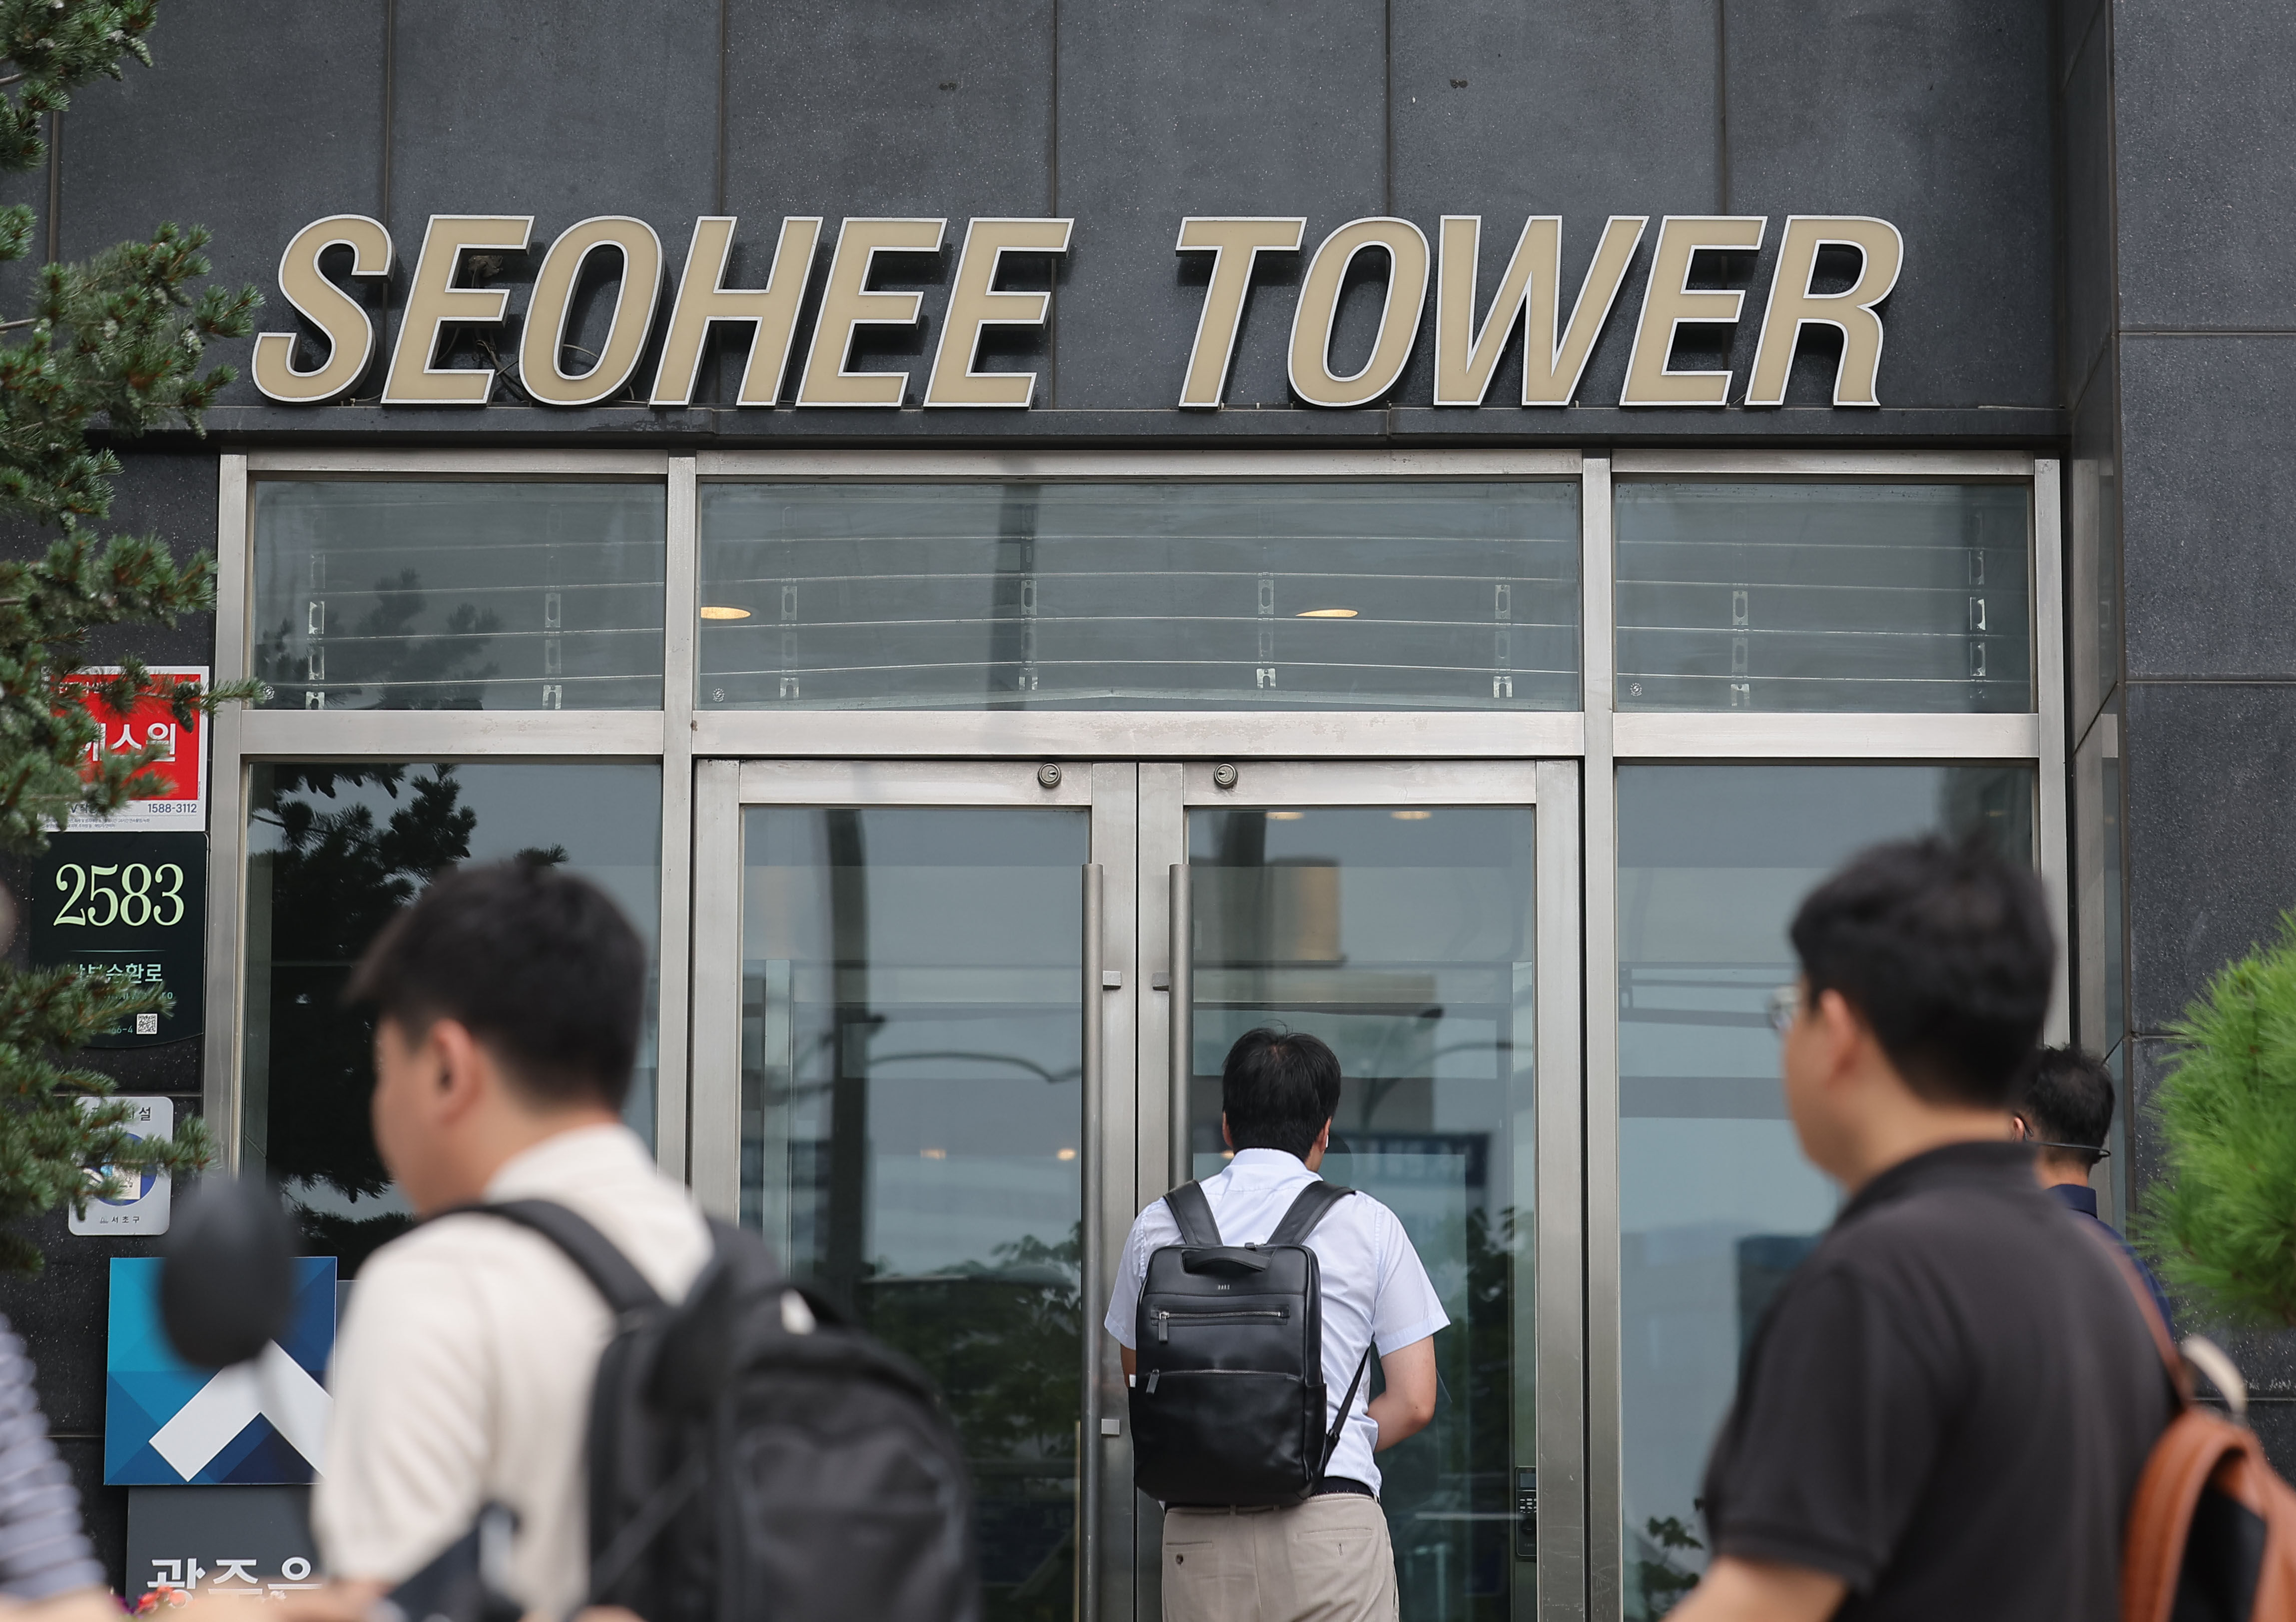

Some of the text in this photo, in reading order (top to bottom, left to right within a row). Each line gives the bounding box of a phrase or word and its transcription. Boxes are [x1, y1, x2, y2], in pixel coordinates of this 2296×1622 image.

[252, 214, 1904, 409] SEOHEE TOWER
[148, 803, 197, 813] 1588-3112
[53, 863, 185, 926] 2583
